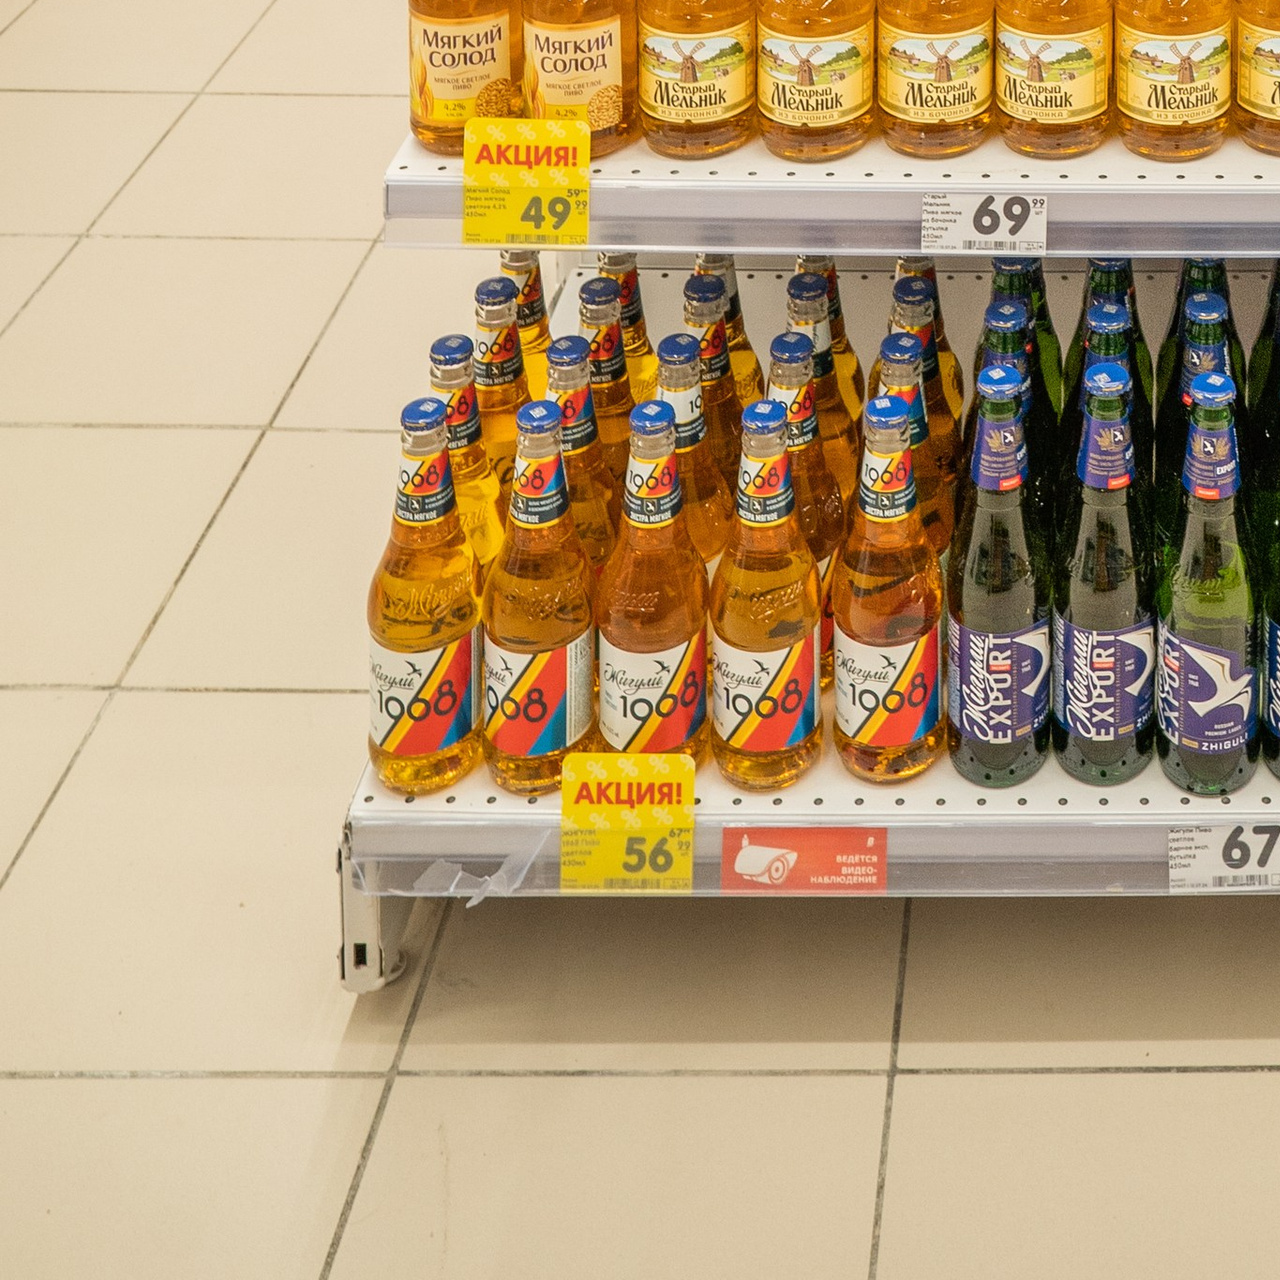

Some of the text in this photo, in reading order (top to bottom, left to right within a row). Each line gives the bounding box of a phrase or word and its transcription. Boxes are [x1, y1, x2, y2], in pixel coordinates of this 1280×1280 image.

[475, 143, 577, 169] АКЦИЯ!
[520, 196, 571, 230] 49
[973, 196, 1031, 236] 69
[849, 672, 928, 713] 1968
[989, 634, 1011, 744] EXPORT
[574, 782, 682, 809] АКЦИЯ!
[622, 836, 673, 873] 56
[836, 854, 878, 863] ВЕДЁТСЯ
[1222, 826, 1280, 869] 67
[811, 875, 878, 884] НАБЛЮДЕНИЕ
[841, 866, 878, 874] ВИДЕО-
